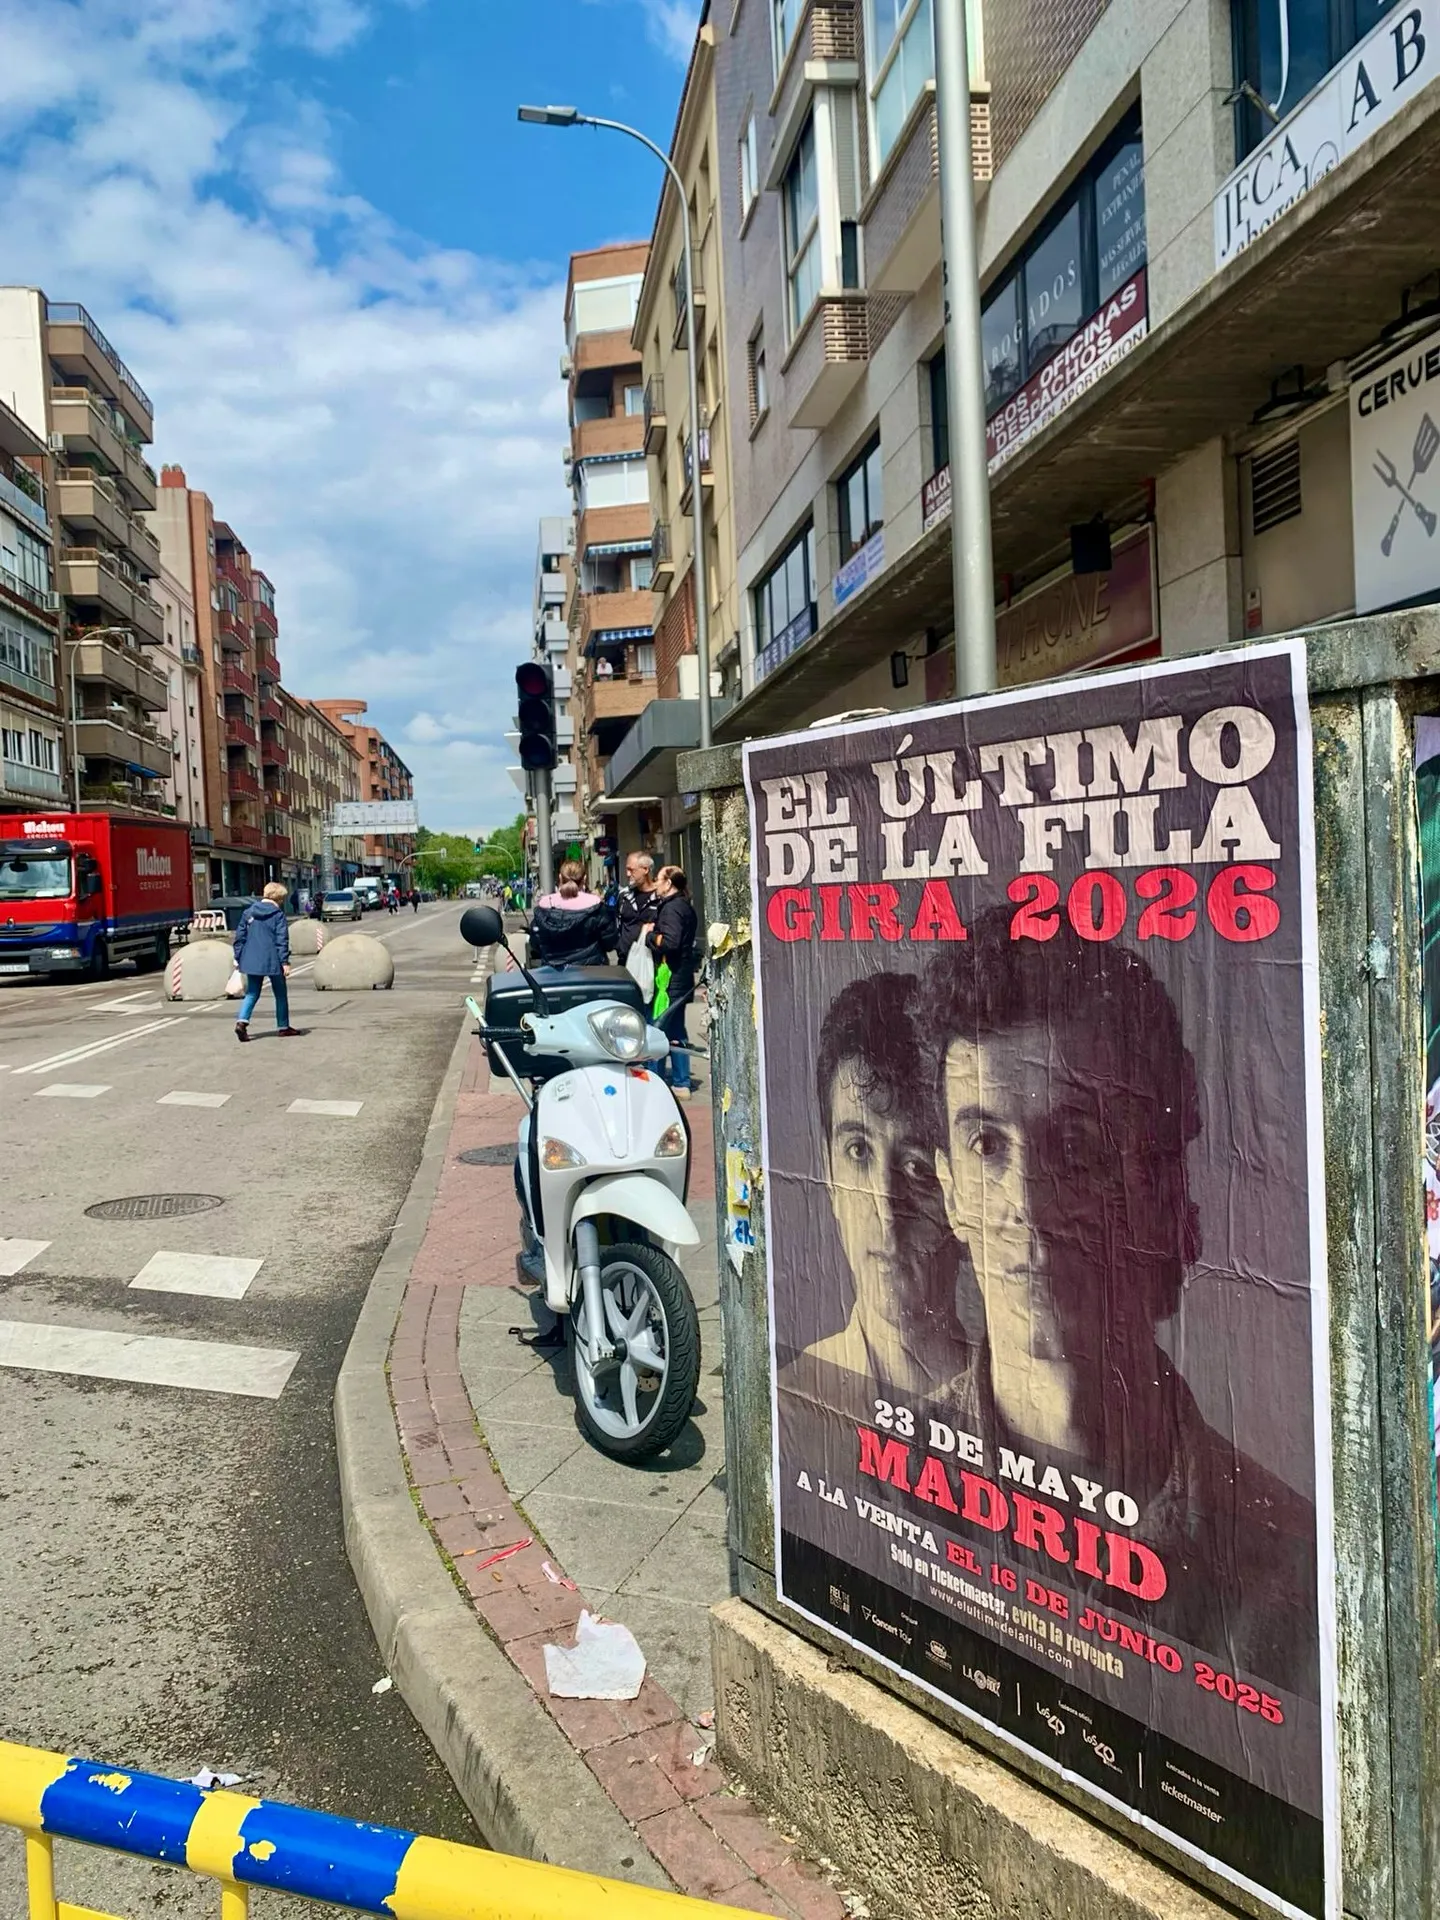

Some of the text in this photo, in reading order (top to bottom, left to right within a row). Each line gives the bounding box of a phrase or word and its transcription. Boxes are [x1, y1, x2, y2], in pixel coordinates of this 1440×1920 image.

[1221, 133, 1301, 258] JFCA
[1040, 282, 1137, 389] OFICINAS
[1060, 323, 1144, 411] APORTACION
[996, 329, 1112, 452] DESPACHOS
[760, 706, 1276, 832] EL ÚLTIMO
[23, 820, 66, 834] Mahou
[136, 848, 172, 876] Mahou
[765, 785, 1281, 886] DE LA FILA
[766, 863, 1281, 941] GIRA 2026
[857, 1427, 1167, 1601] MADRID
[875, 1399, 1140, 1527] 23 DE MAYO
[797, 1471, 1284, 1724] A LA VENTA EL 16 DE JUNIO 2025
[872, 1614, 898, 1636] Concert
[915, 1558, 929, 1578] en
[1012, 1605, 1047, 1639] evita
[1050, 1621, 1064, 1646] la
[1066, 1632, 1124, 1680] reventa
[930, 1585, 1073, 1670] www.elultimodelafila.com
[1161, 1780, 1223, 1823] ticketmaster
